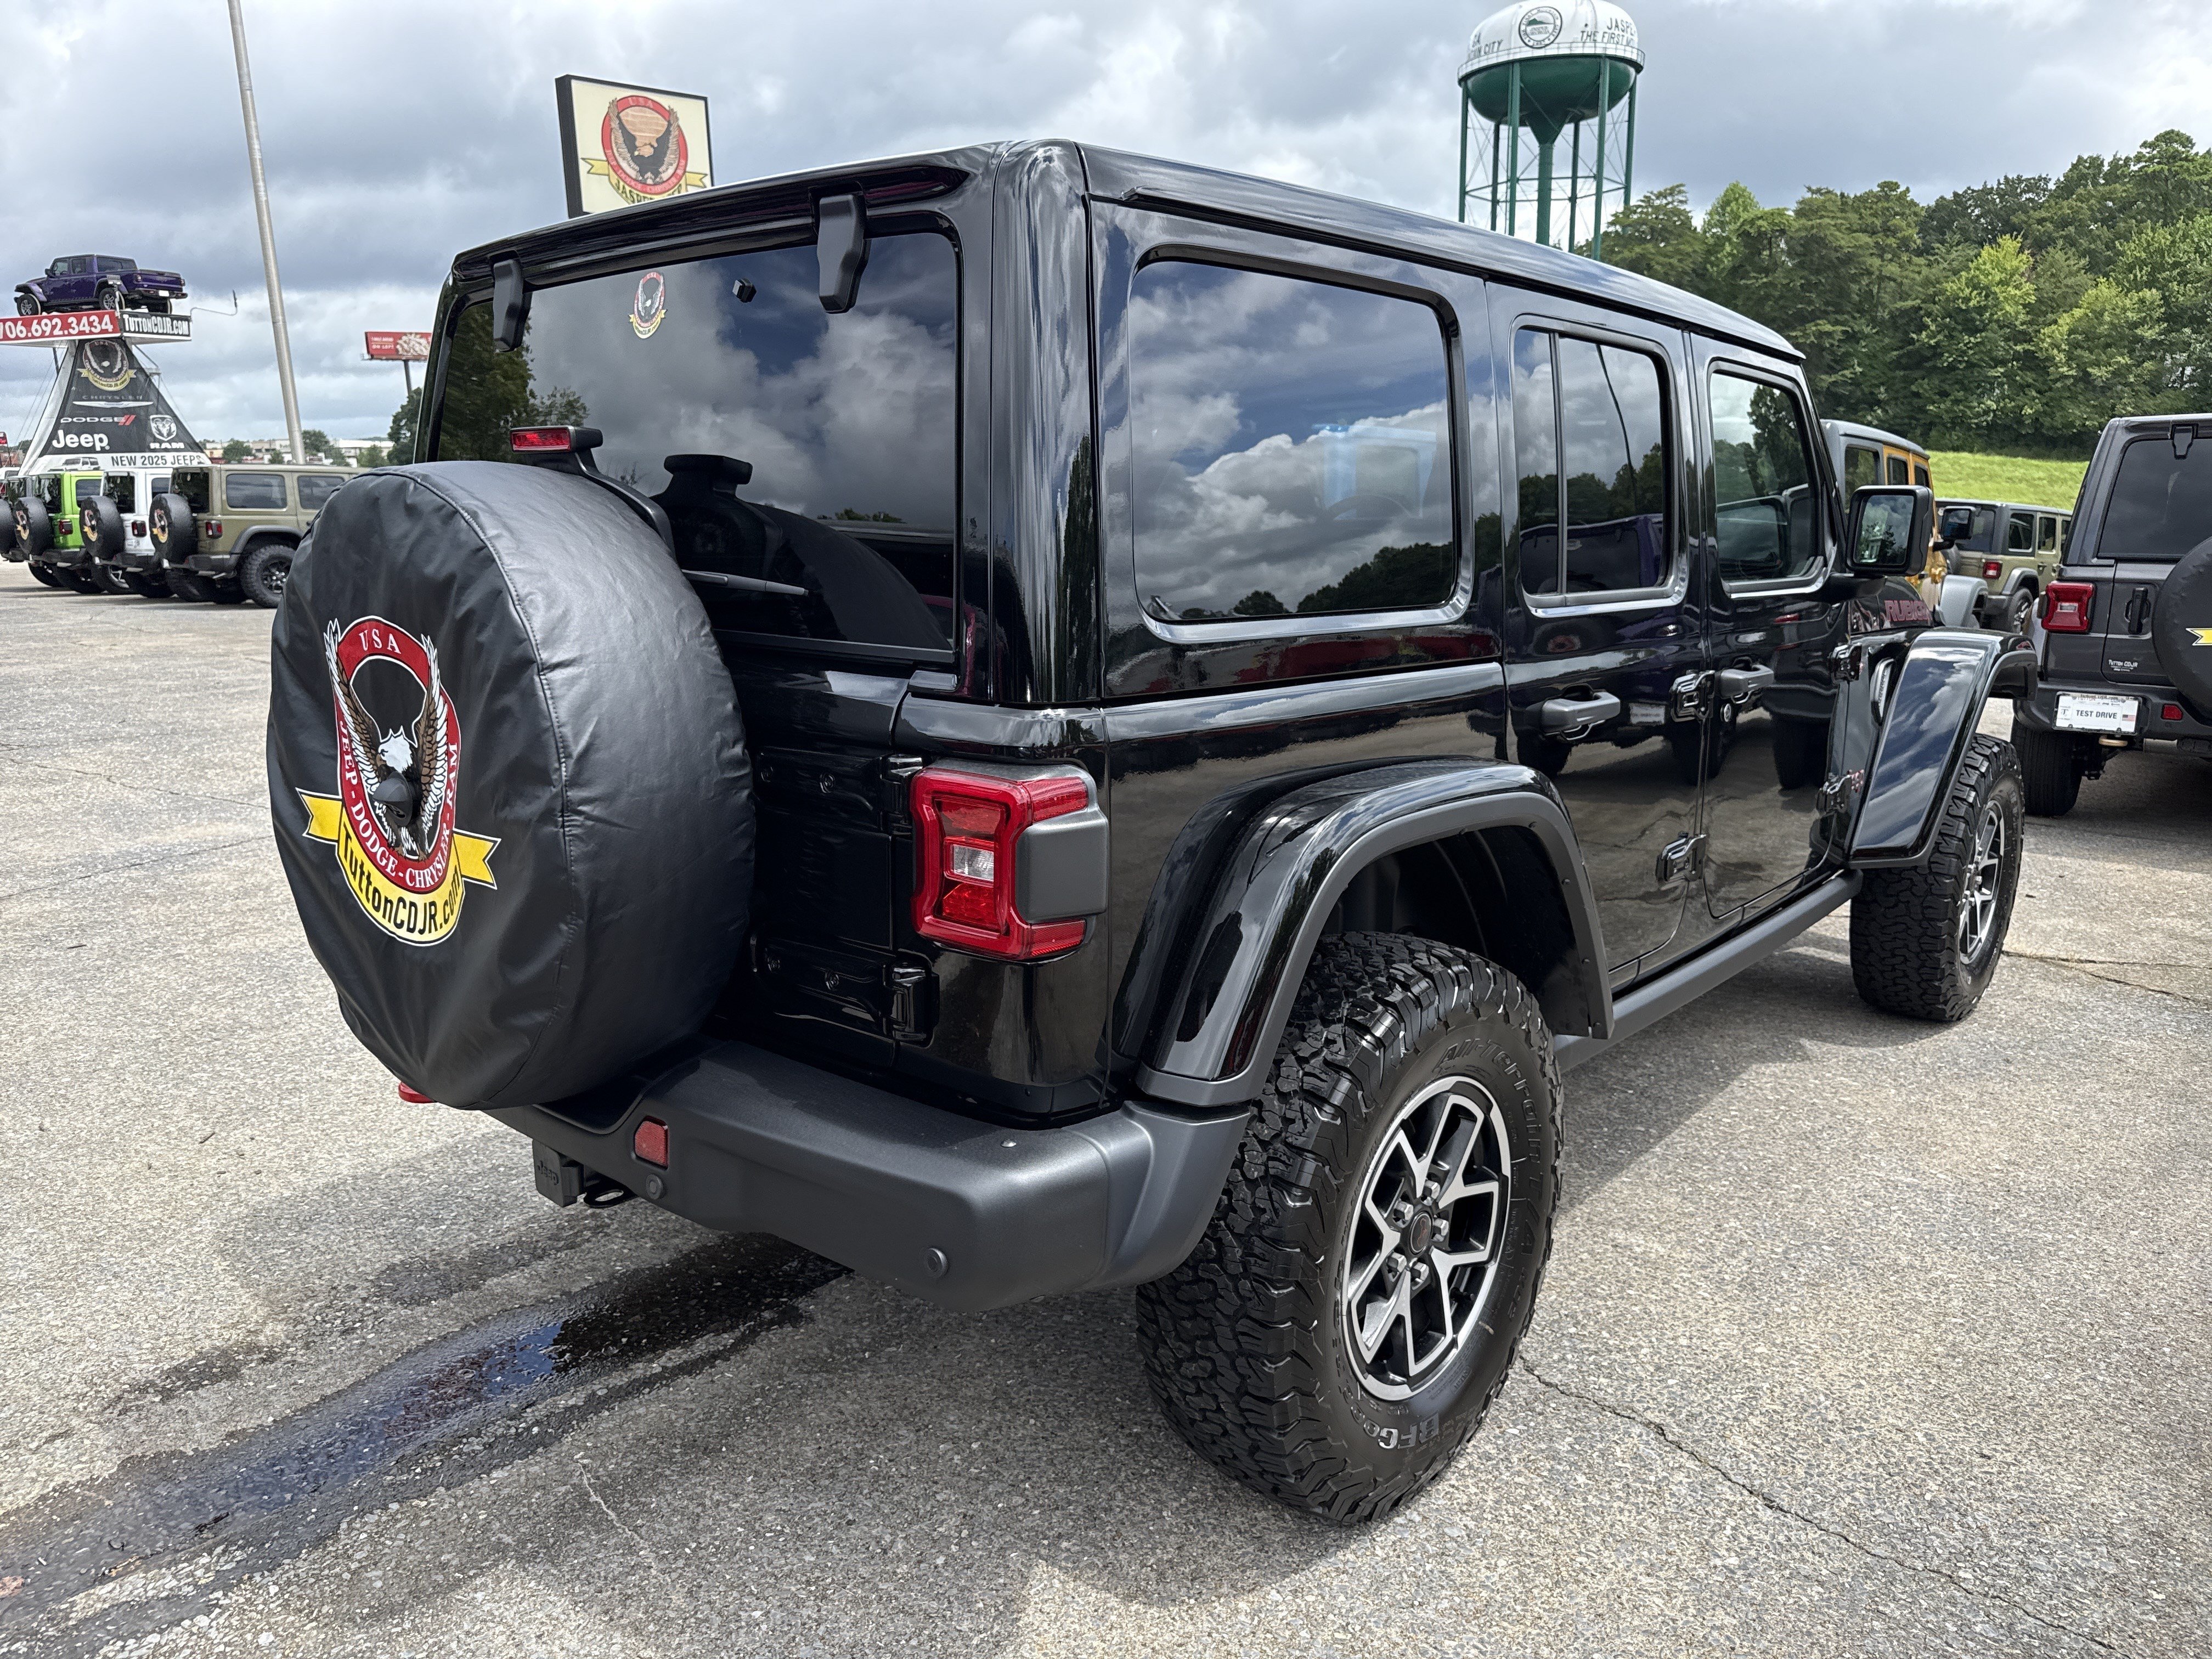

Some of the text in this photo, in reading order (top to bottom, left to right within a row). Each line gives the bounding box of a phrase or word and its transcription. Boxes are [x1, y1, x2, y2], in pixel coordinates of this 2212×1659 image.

[1581, 30, 1599, 42] THE
[1601, 31, 1625, 44] FIRST
[52, 430, 109, 451] Jeep
[111, 455, 137, 466] NEW
[140, 455, 167, 466] 2025
[359, 629, 402, 654] USA
[2076, 709, 2094, 718] TEST
[2095, 710, 2118, 719] DRIVE
[340, 720, 458, 889] JEEP DODGE CHRYSLER RAM
[343, 820, 461, 935] TuttonCDJR.com
[538, 1160, 560, 1186] Jeep
